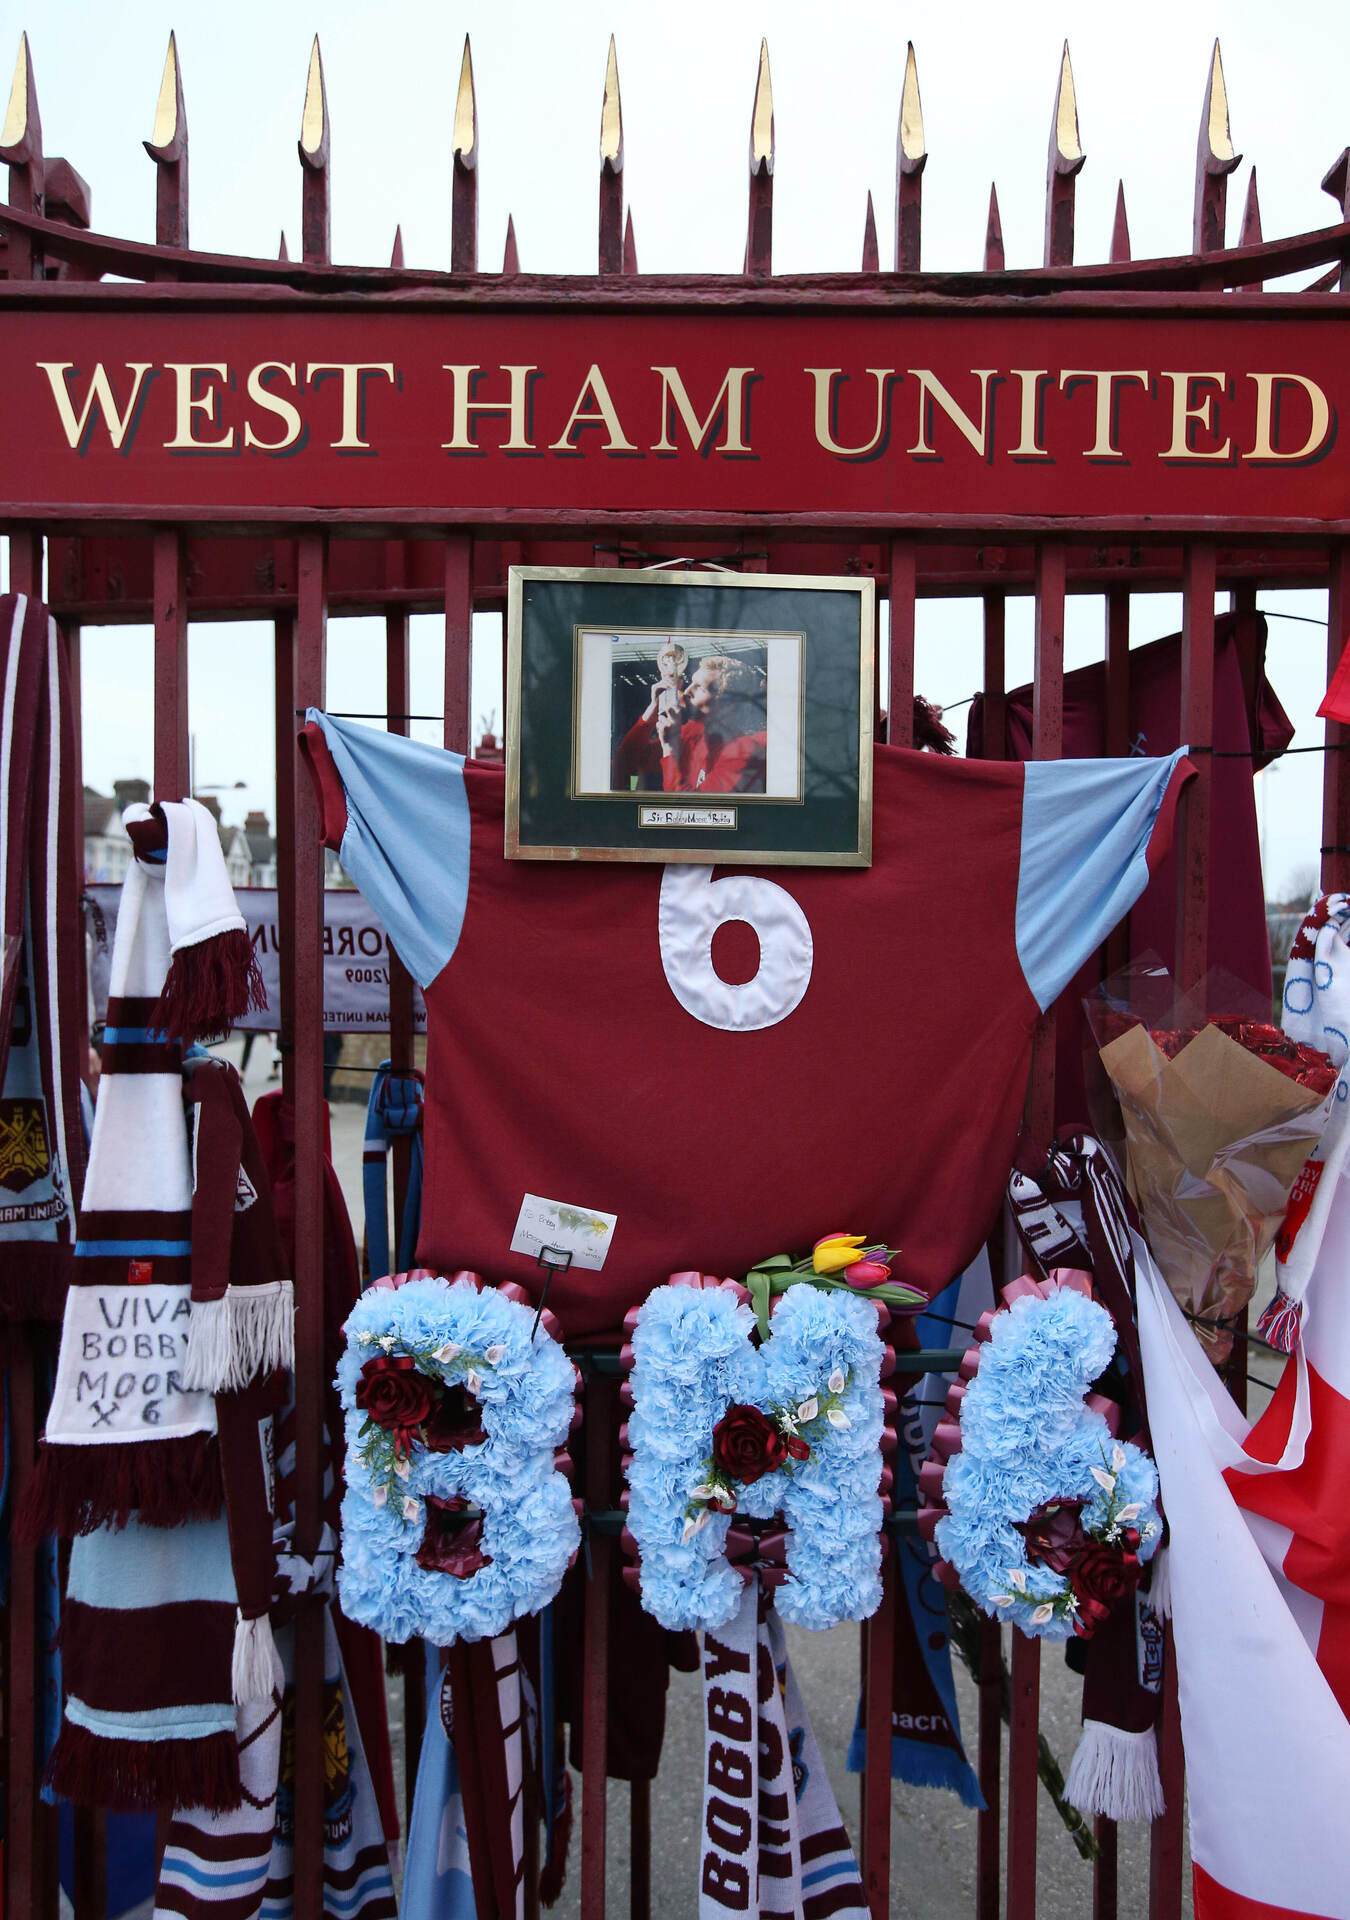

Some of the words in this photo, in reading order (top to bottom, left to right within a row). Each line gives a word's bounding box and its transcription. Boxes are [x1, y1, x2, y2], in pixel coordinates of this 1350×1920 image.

[36, 361, 397, 452] WEST
[440, 364, 757, 455] HAM
[804, 368, 1331, 462] UNITED
[657, 866, 815, 1033] 6
[99, 1296, 192, 1330] VIVA
[76, 1370, 200, 1402] MOOR
[141, 1399, 161, 1426] 6
[934, 1286, 1162, 1641] 6
[891, 1711, 949, 1731] acr
[701, 1630, 752, 1912] BOBBY
